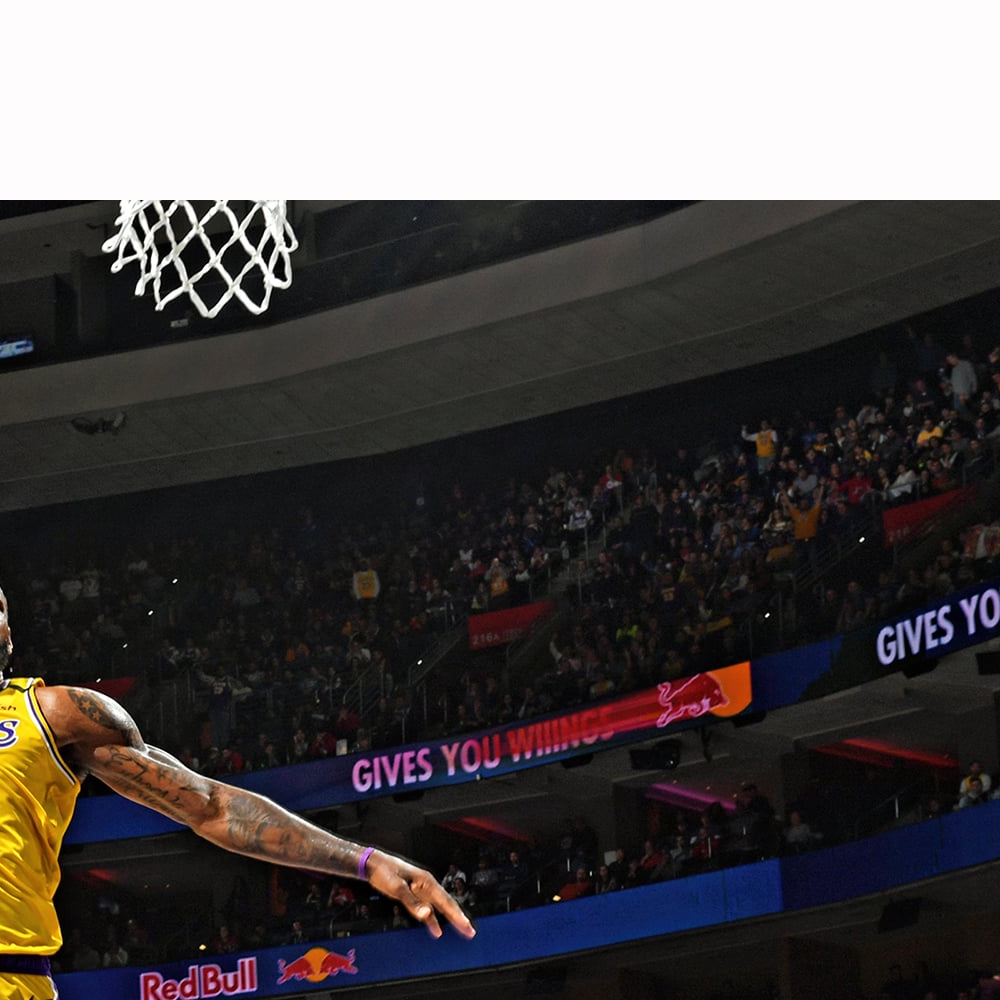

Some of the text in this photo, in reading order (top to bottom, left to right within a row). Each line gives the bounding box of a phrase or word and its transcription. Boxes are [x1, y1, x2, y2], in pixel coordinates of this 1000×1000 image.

[877, 588, 1000, 665] GIVES YO
[352, 748, 433, 792] GIVES
[440, 734, 501, 776] YOU
